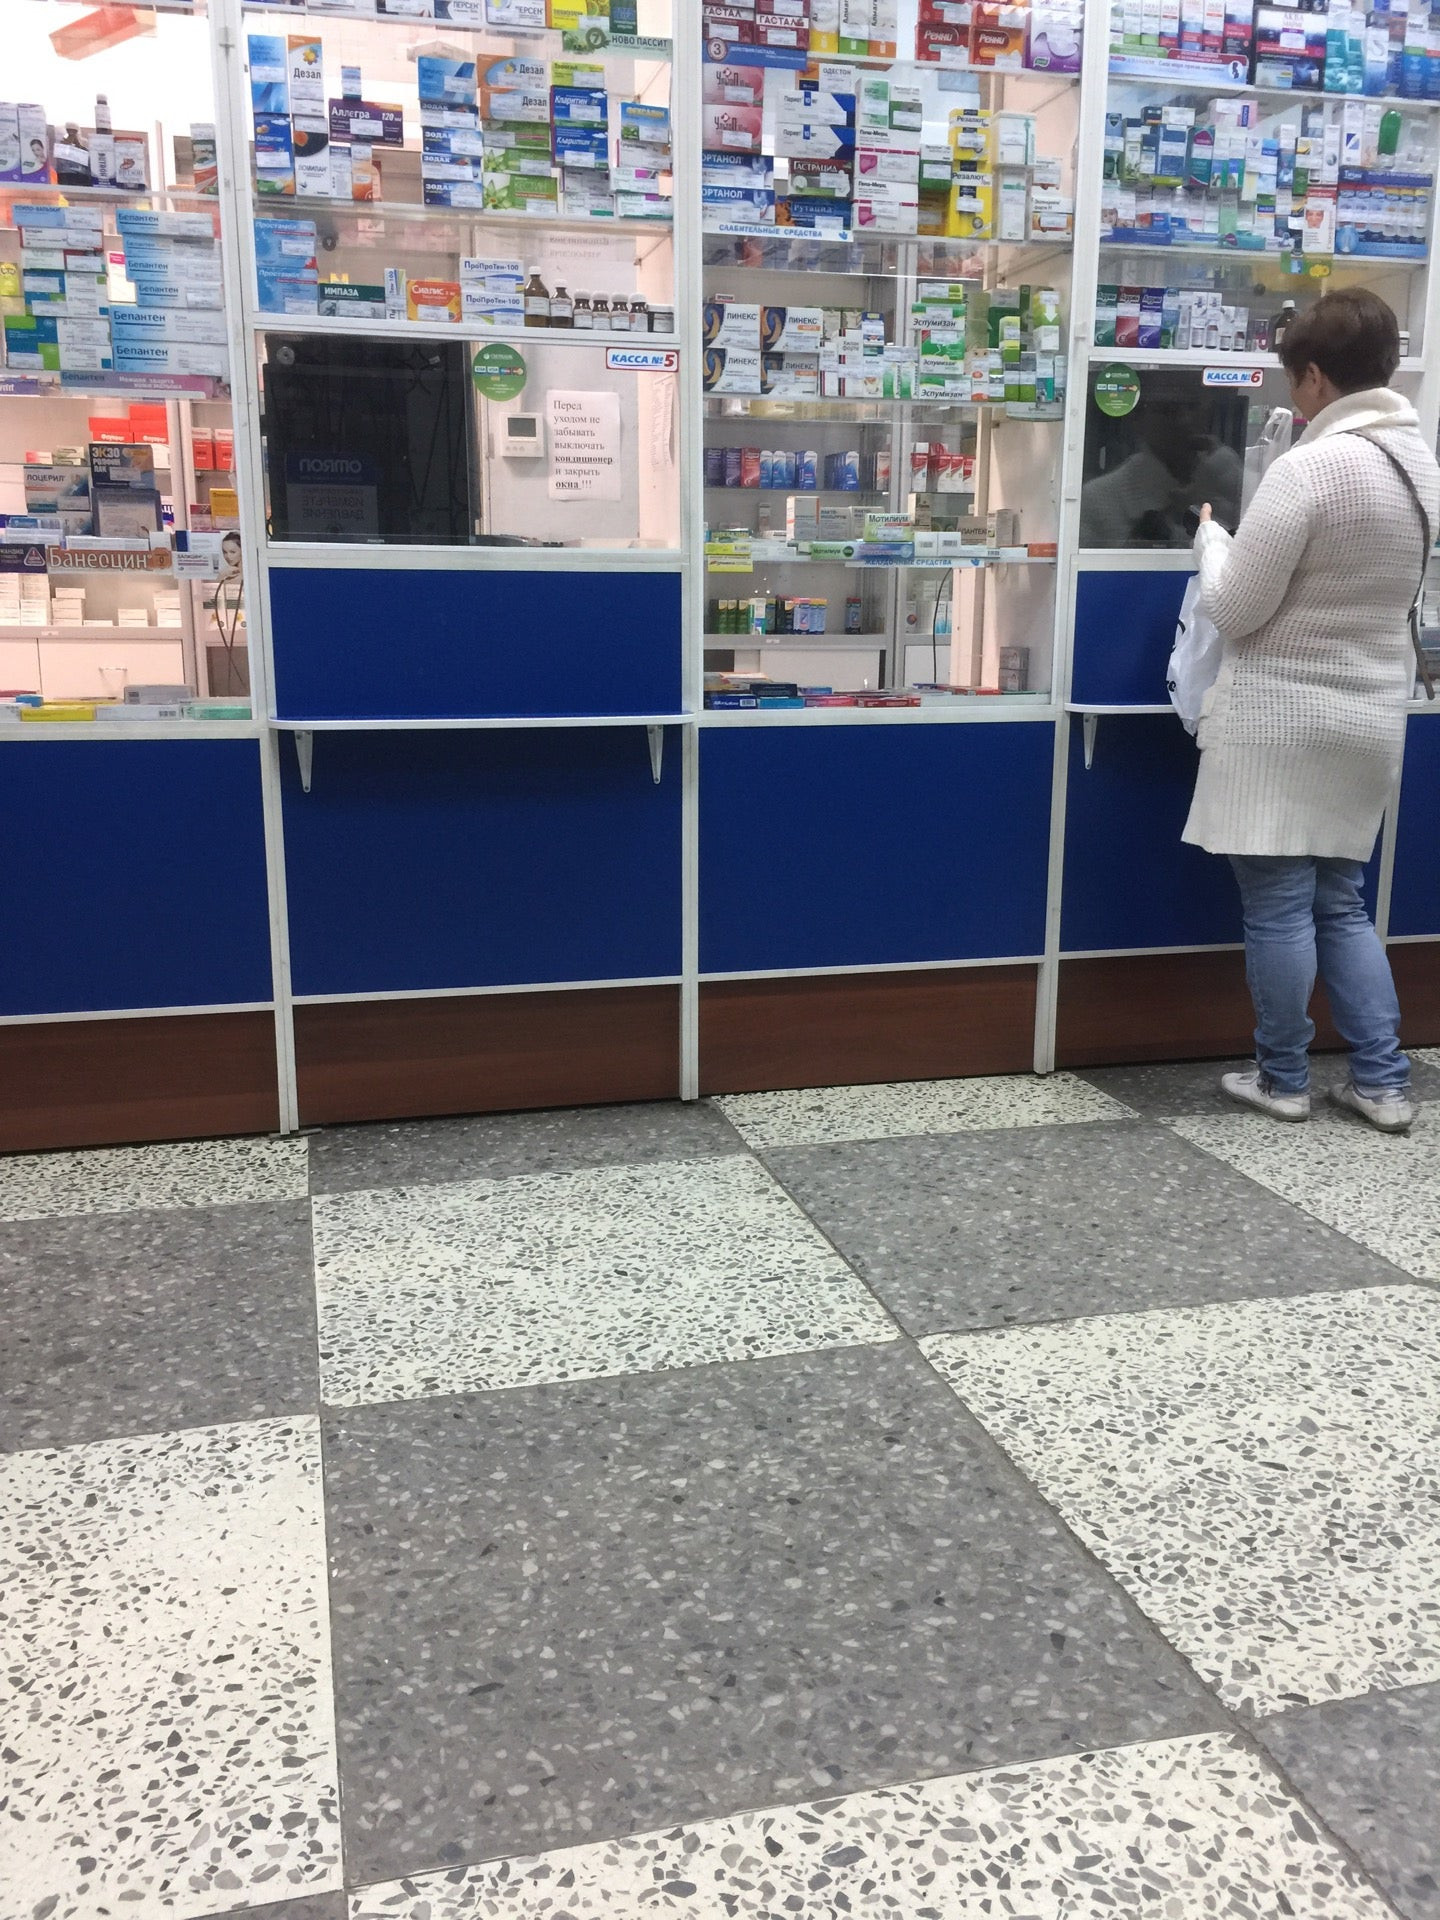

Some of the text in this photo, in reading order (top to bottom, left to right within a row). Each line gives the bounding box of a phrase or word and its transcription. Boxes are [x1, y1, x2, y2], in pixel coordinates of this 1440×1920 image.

[703, 6, 742, 18] ГАСТАЛ
[591, 32, 600, 43] 7
[611, 35, 667, 47] НОВО ПАССИТ
[924, 30, 953, 42] Ренни
[979, 33, 1005, 44] Ренни
[713, 43, 722, 56] 3
[293, 67, 322, 80] Дезал
[519, 64, 545, 74] Дезал
[522, 96, 547, 107] Дезал
[554, 94, 588, 105] Кларитин
[331, 106, 370, 120] Аллегра
[382, 112, 395, 121] 120
[702, 154, 742, 164] ОРТАНОЛ
[953, 172, 984, 181] Резалют
[702, 189, 743, 199] ОРТАНОЛ
[118, 213, 159, 223] Бепантен
[719, 224, 823, 238] СЛАБИТЕЛЬНЫЕ СРЕДСТВА
[128, 260, 168, 270] Бепантен
[464, 260, 520, 272] ПроПроТен-100
[138, 284, 179, 294] Бепантен
[324, 287, 359, 297] ИМПАЗА
[465, 294, 521, 306] ПроПроТен-100
[113, 311, 166, 322] Бепантен
[727, 313, 758, 321] ЛИНЕКС
[788, 317, 818, 325] ЛИНЕКС
[913, 318, 956, 328] Эспумизан
[116, 345, 169, 357] Бепантен
[611, 354, 649, 364] КАССА
[728, 357, 758, 365] ЛИНЕКС
[923, 359, 956, 367] Эспумизан
[785, 362, 814, 370] ЛИНЕКС
[1207, 372, 1239, 381] КАССА
[921, 390, 963, 398] Эспумизан
[553, 400, 582, 411] Перед
[554, 415, 600, 425] уходом не
[554, 427, 595, 437] забывать
[554, 441, 605, 450] выключать
[555, 455, 613, 465] кондиционер
[27, 474, 64, 482] ЛОЦЕРИЛ
[564, 468, 600, 478] закрыть
[555, 480, 579, 489] окна
[868, 514, 908, 523] Мотилиум
[50, 550, 147, 571] Банеоцин
